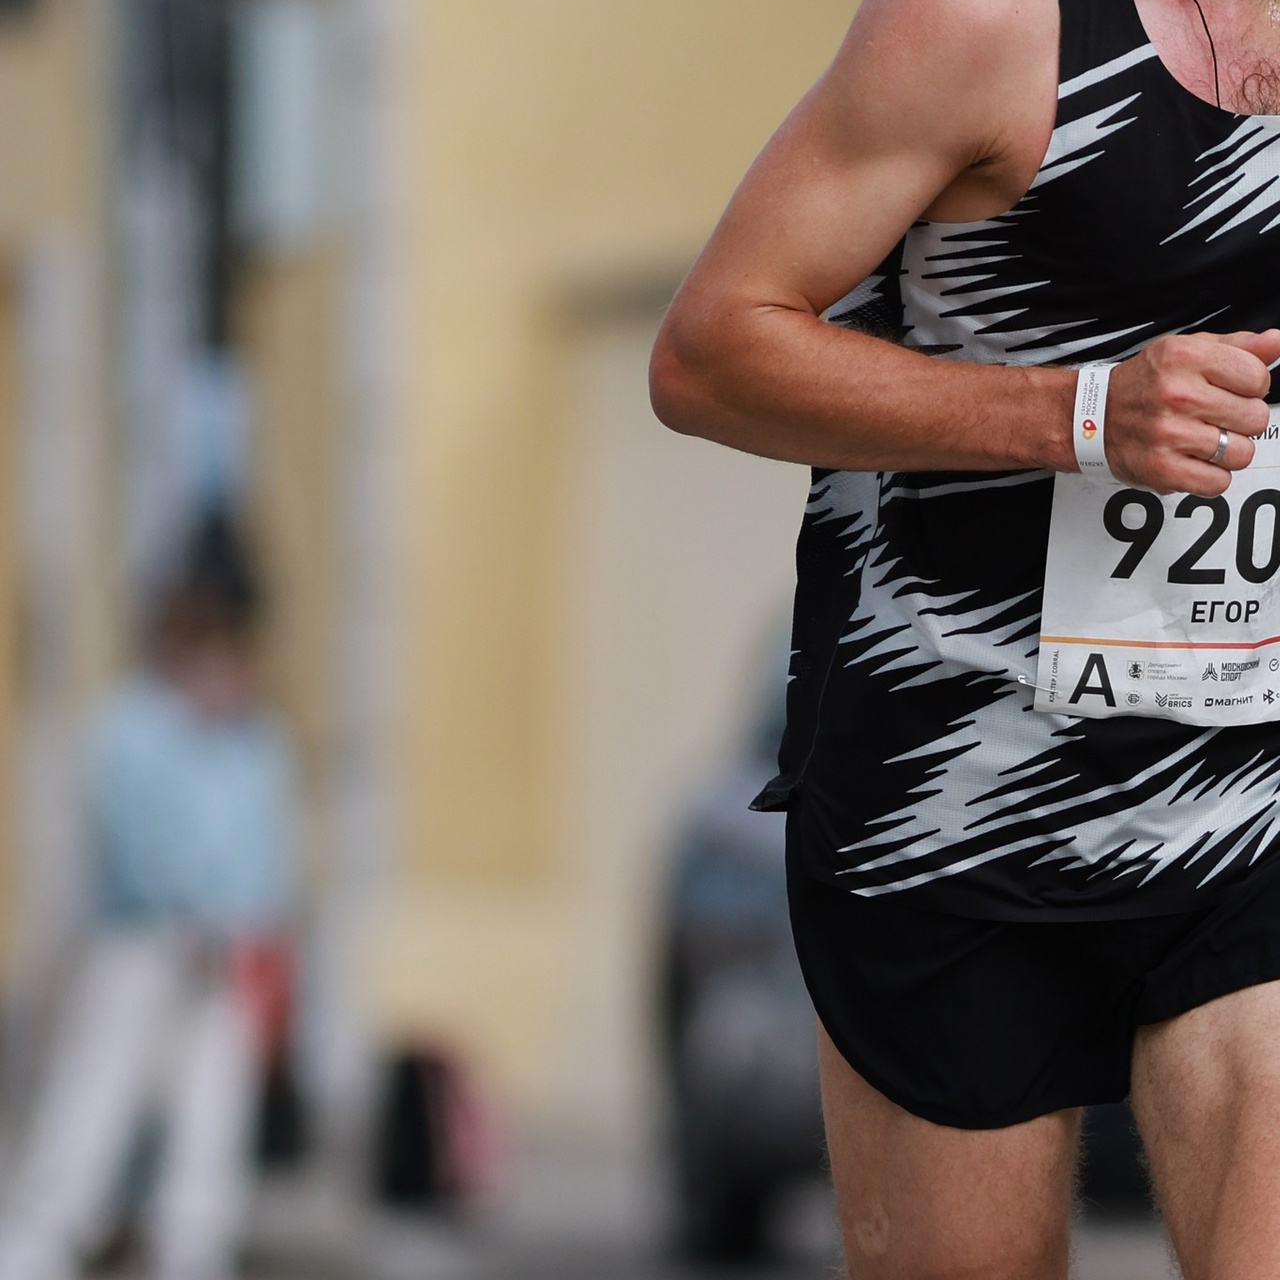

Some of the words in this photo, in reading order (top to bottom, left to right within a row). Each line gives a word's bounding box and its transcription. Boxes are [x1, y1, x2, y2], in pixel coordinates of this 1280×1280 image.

[1085, 371, 1096, 416] МОСКОВСКИЙ
[1091, 382, 1100, 416] МАРАФОН
[1190, 600, 1260, 624] ЕГОР
[1051, 649, 1060, 673] CORRAL
[1220, 672, 1243, 682] СПОРТ
[1167, 700, 1193, 708] BRICS
